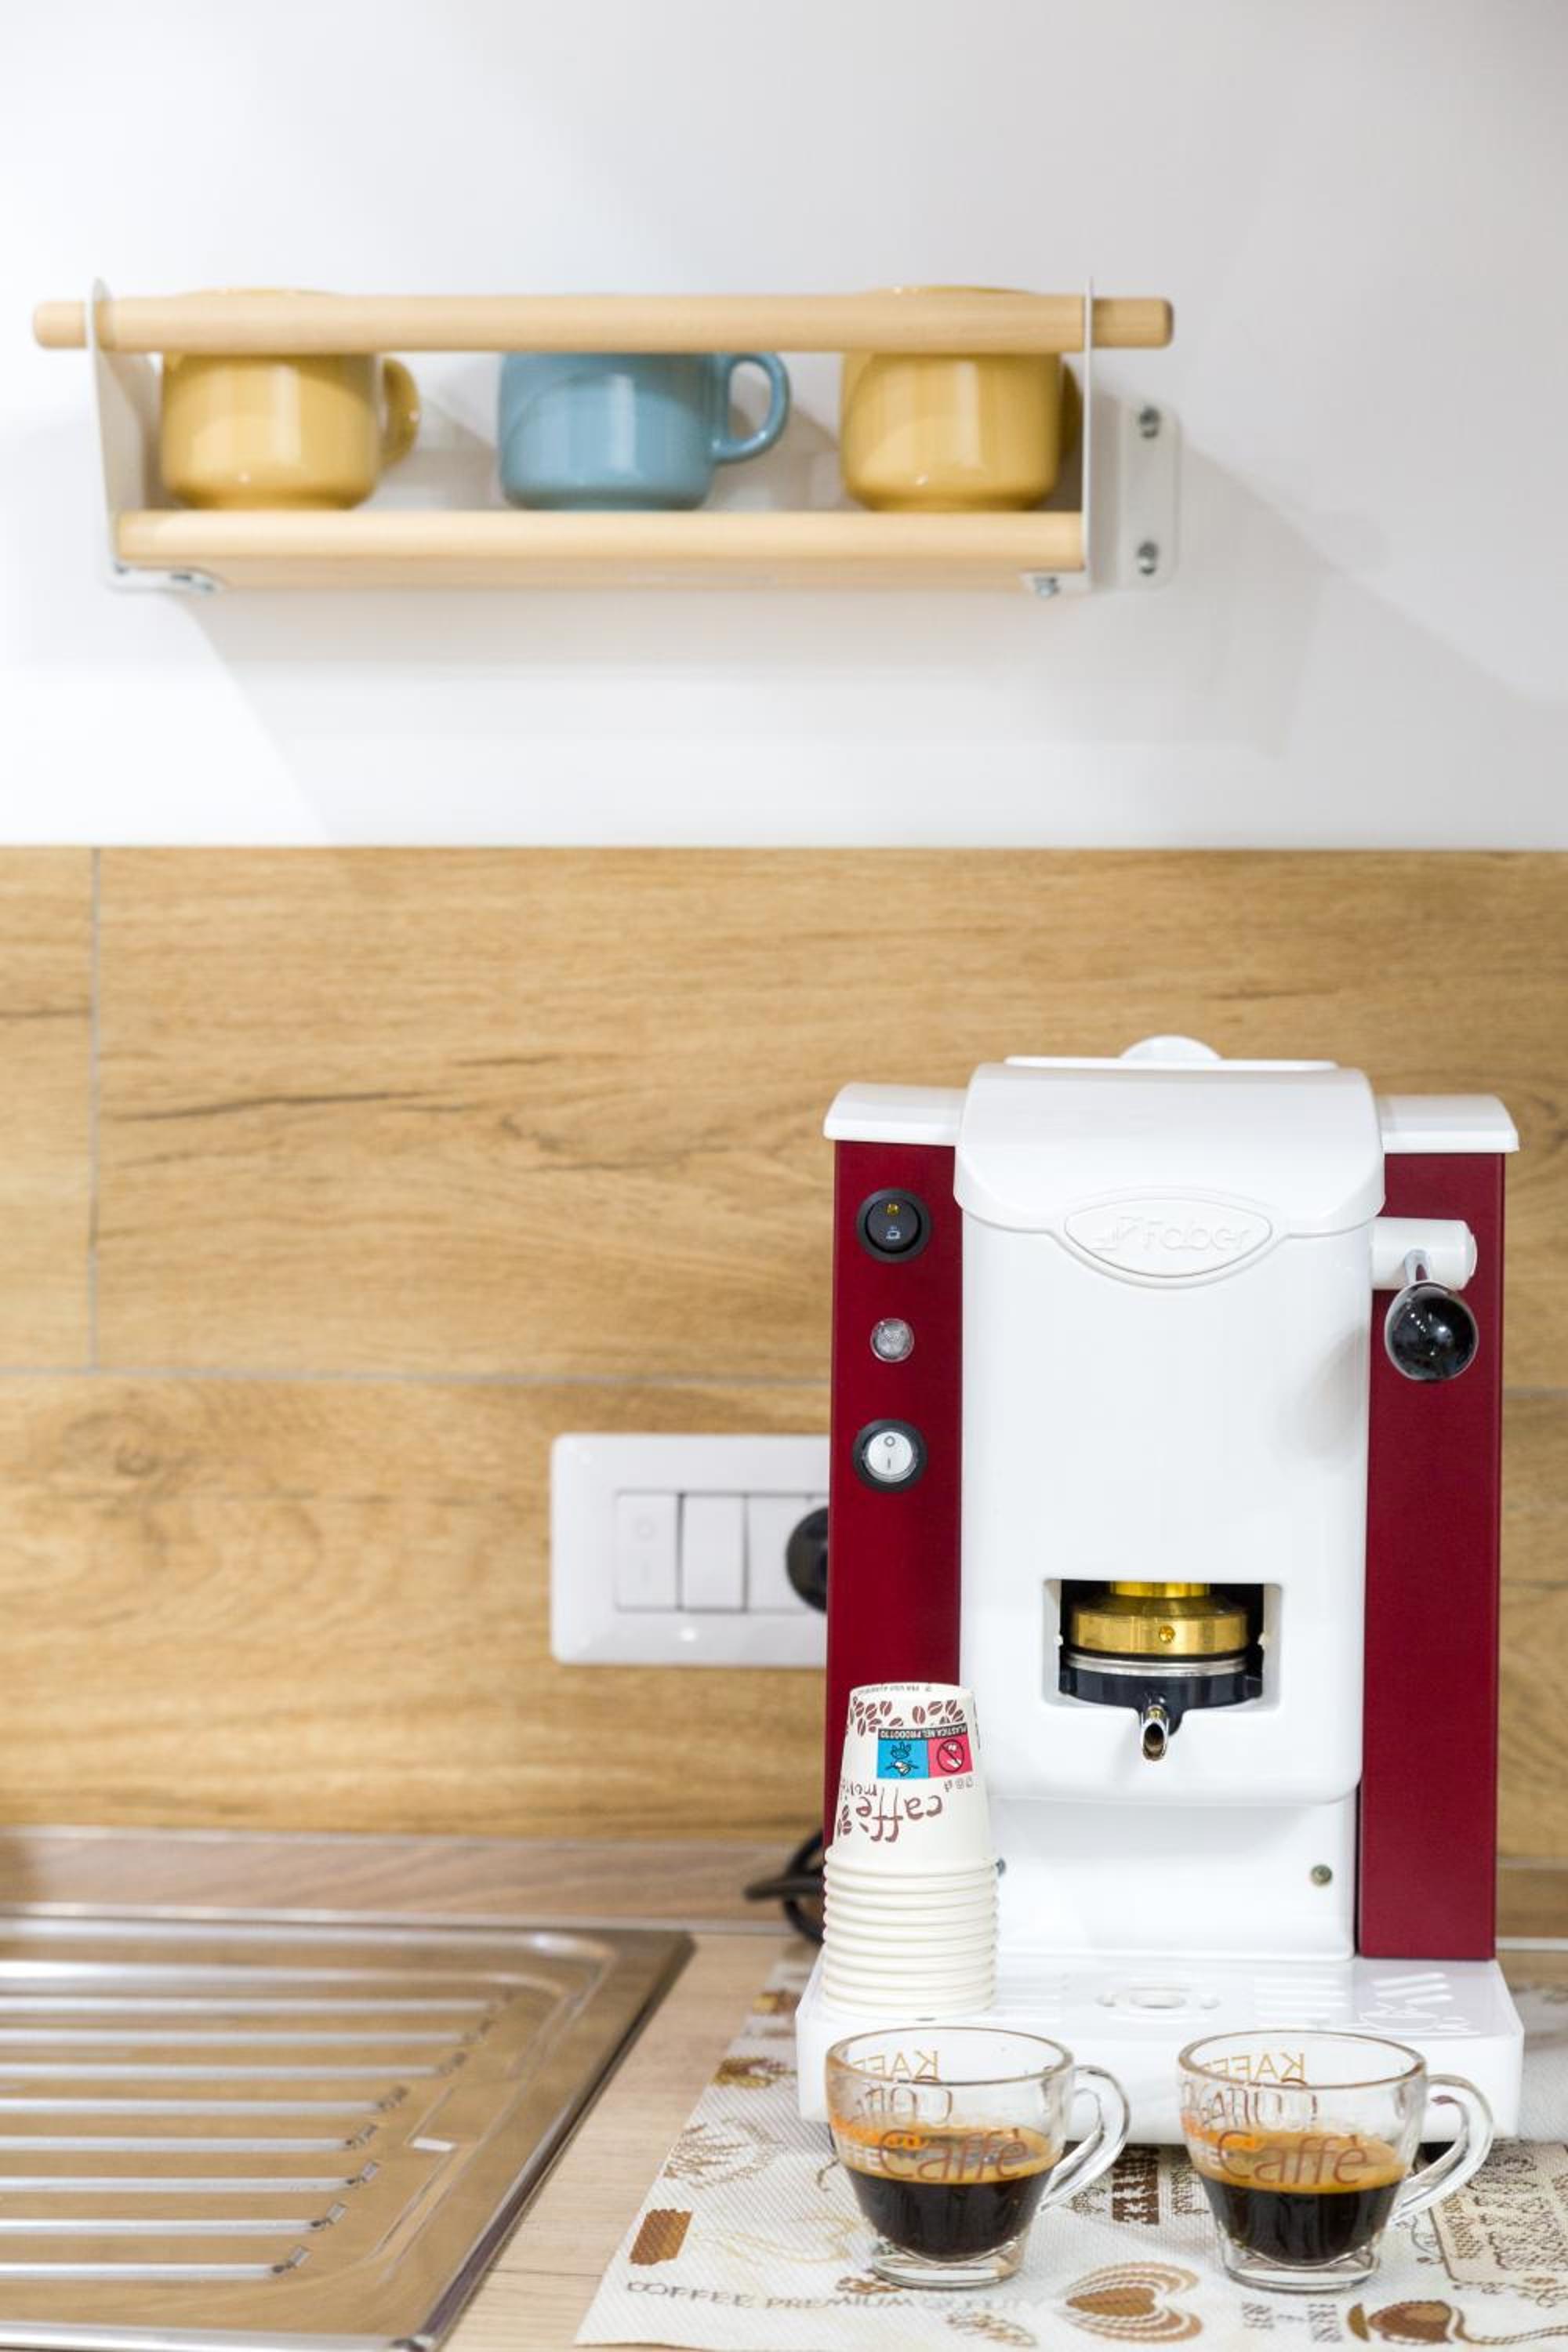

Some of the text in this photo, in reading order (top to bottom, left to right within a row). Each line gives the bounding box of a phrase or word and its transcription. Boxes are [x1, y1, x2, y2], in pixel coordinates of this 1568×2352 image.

[937, 1726, 967, 1737] PLASTICA
[879, 2127, 1030, 2182] Caffè
[1217, 2130, 1370, 2185] Caffè
[627, 2281, 754, 2308] COFFEE
